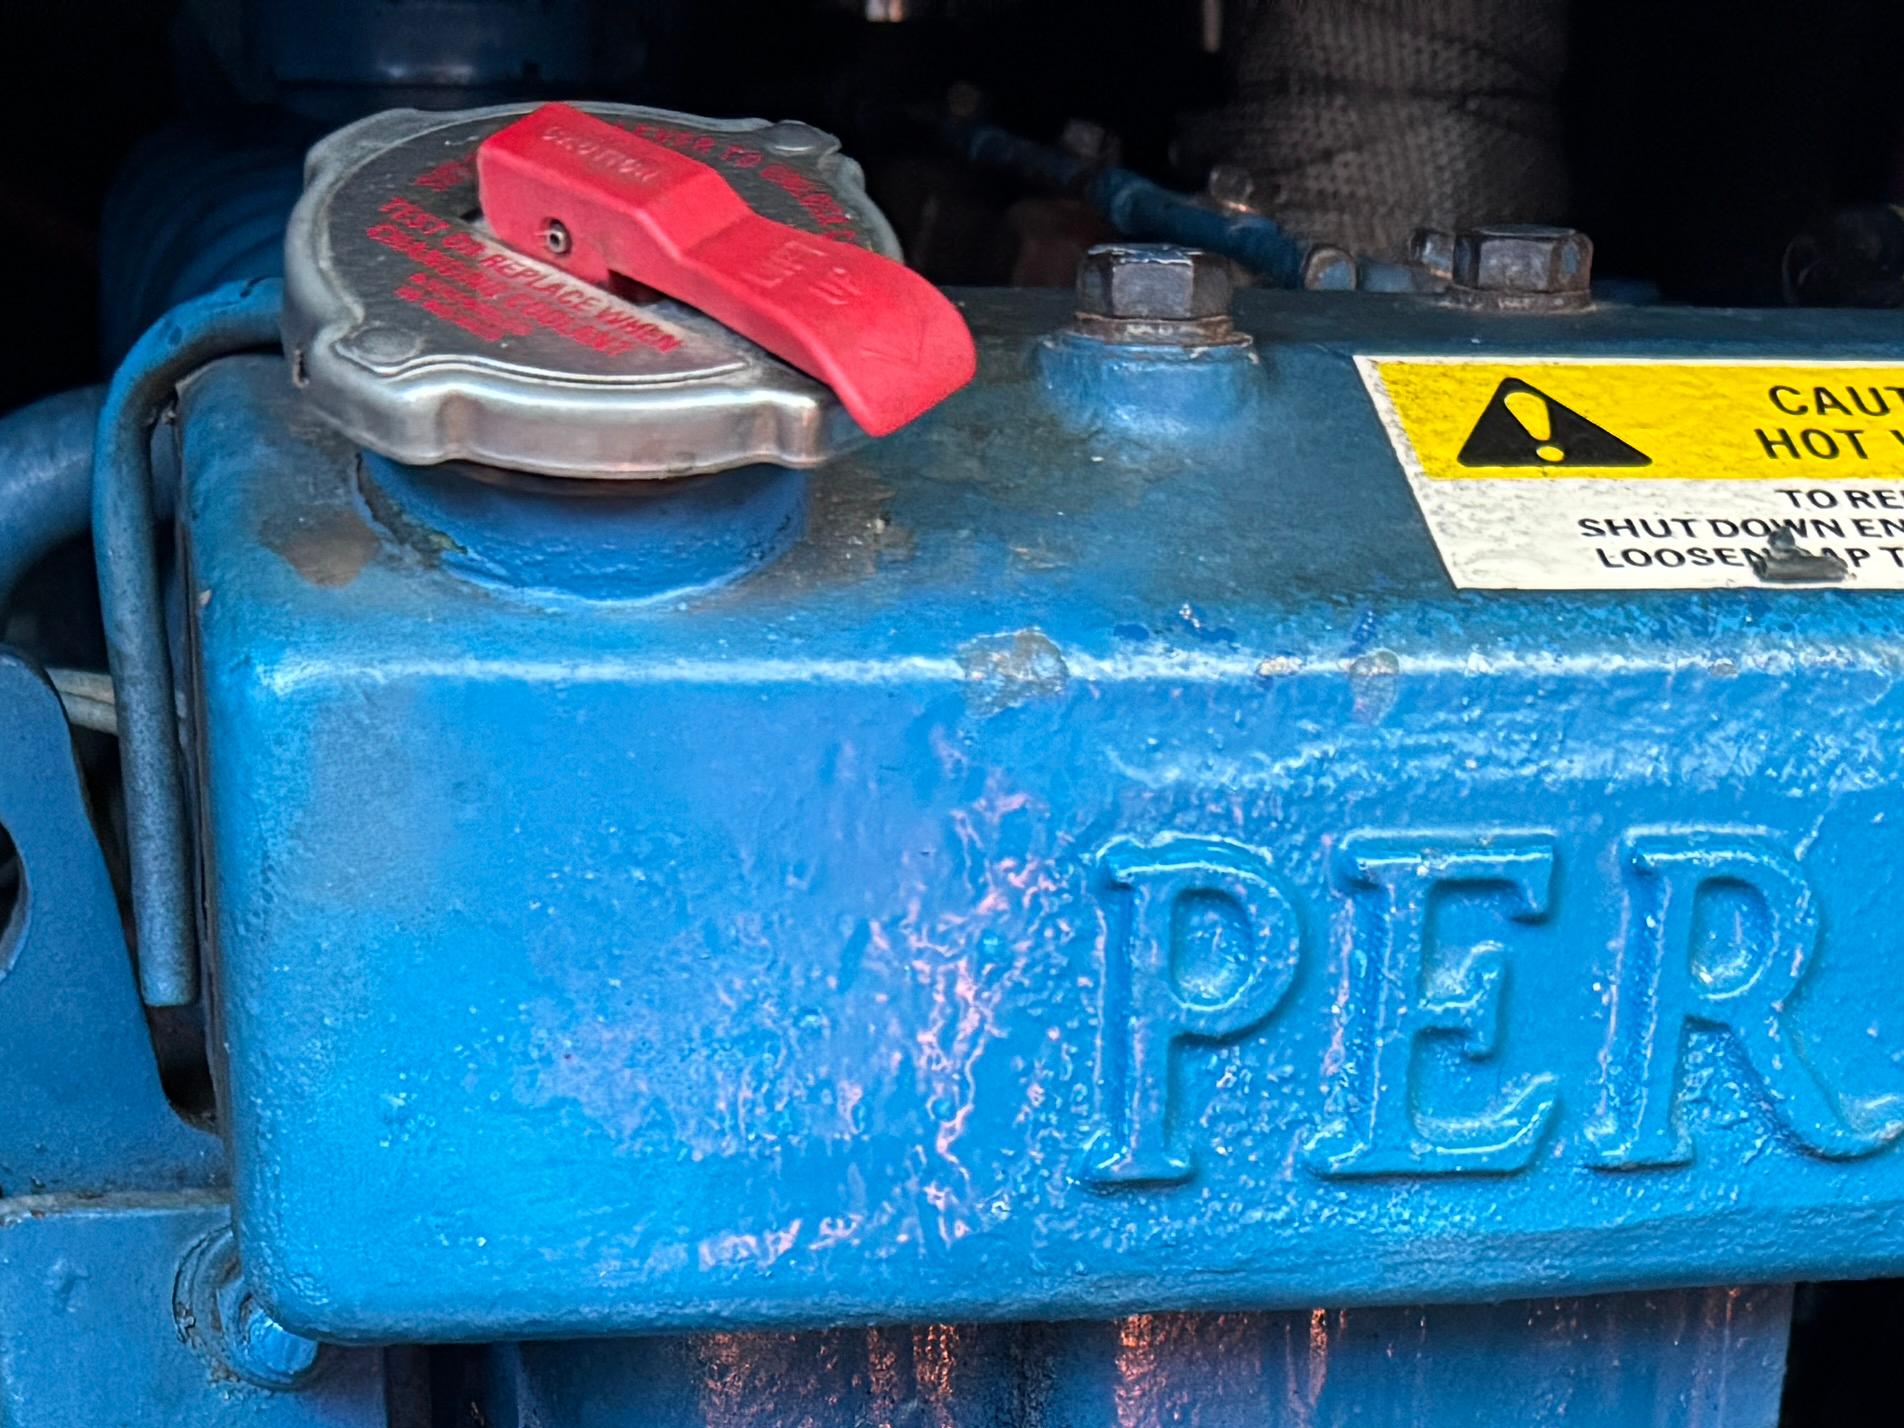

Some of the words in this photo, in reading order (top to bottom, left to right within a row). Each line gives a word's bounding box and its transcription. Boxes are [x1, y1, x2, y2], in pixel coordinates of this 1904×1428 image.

[478, 250, 599, 314] REPLACE
[595, 306, 688, 353] WHEN
[1753, 427, 1870, 461] HOT
[1775, 488, 1838, 511] TO
[1577, 517, 1700, 539] SHUT
[1706, 517, 1846, 539] DOWN
